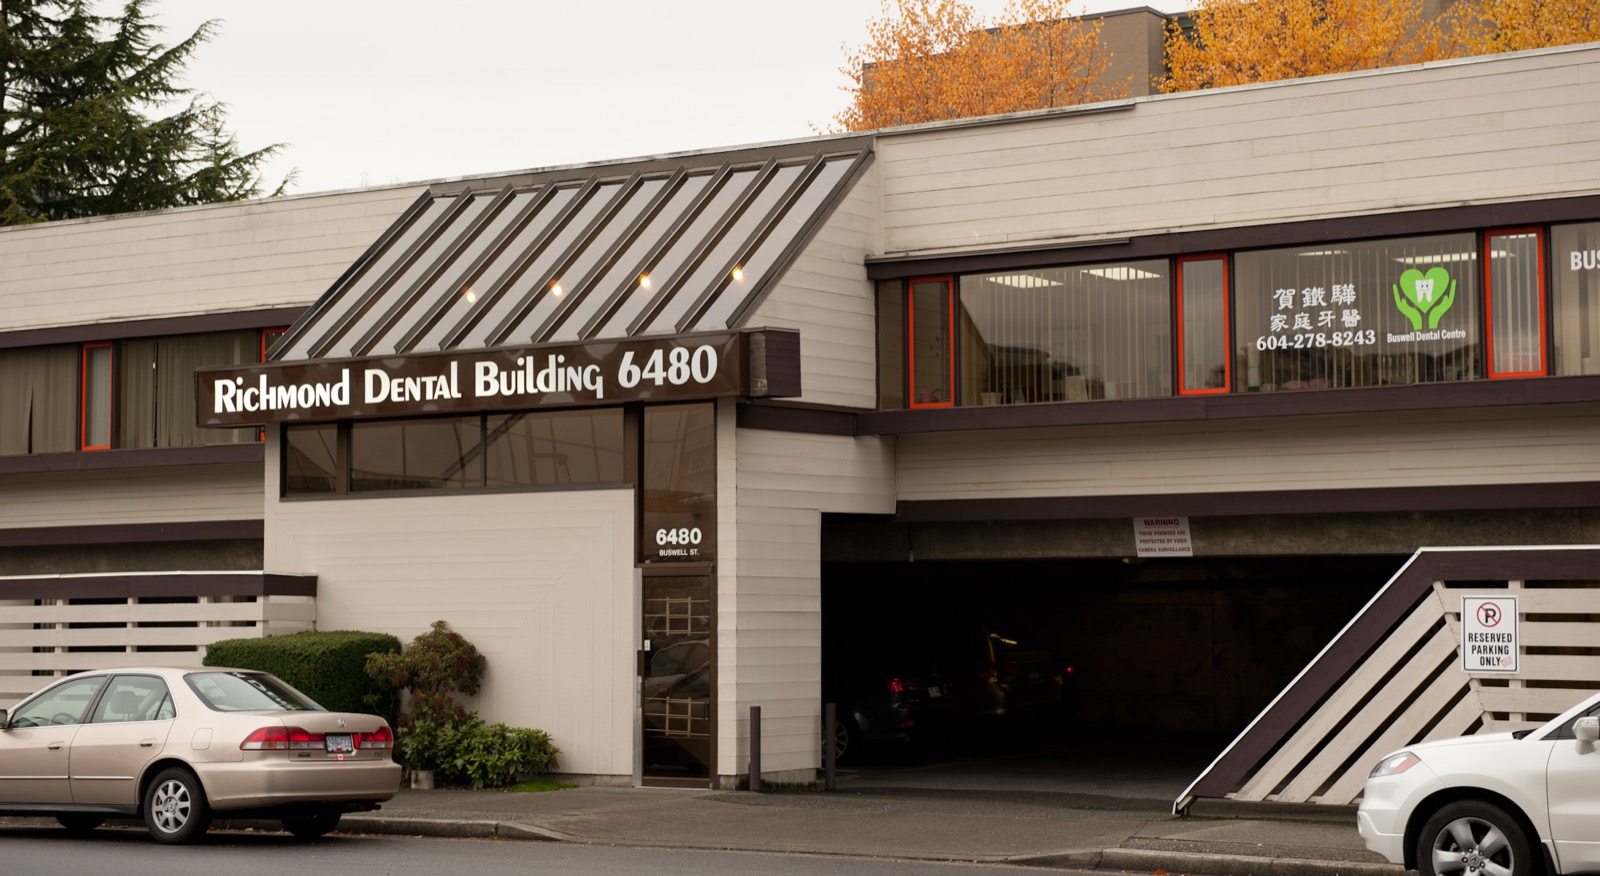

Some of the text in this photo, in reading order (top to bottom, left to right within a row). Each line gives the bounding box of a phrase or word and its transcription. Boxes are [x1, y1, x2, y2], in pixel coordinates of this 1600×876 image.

[1256, 329, 1376, 351] 604-278-8243
[1387, 329, 1466, 343] Buswell Dental Centre
[214, 368, 350, 413] Richmond
[474, 354, 604, 399] Building
[617, 345, 718, 388] 6480
[1143, 518, 1180, 527] WARNING
[656, 527, 702, 545] 6480
[659, 548, 700, 556] BUSWELL ST.
[1468, 632, 1512, 643] RESERVED
[1471, 645, 1509, 655] PARKING
[1479, 656, 1501, 666] ONLY
